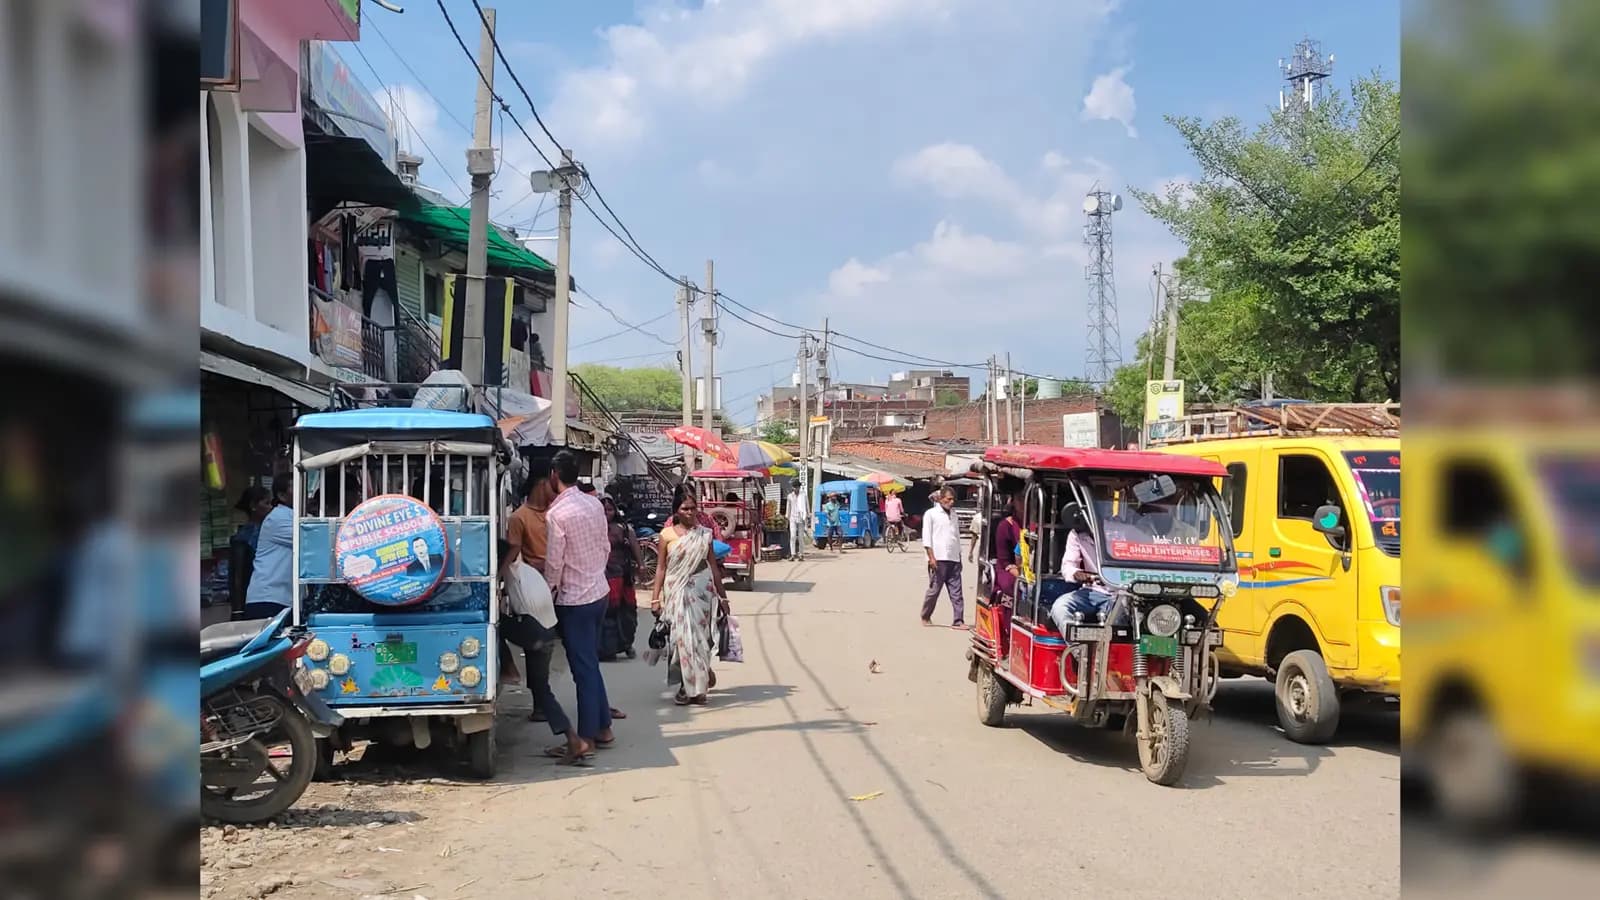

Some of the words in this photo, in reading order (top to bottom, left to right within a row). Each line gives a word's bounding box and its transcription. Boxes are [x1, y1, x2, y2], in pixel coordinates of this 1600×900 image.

[350, 531, 382, 547] PUBLIC
[383, 516, 425, 537] SCHOOL
[354, 514, 393, 536] DIVINE
[392, 506, 422, 524] EYE'S
[1154, 546, 1211, 557] ENTERPRISES
[1119, 569, 1208, 583] Panther
